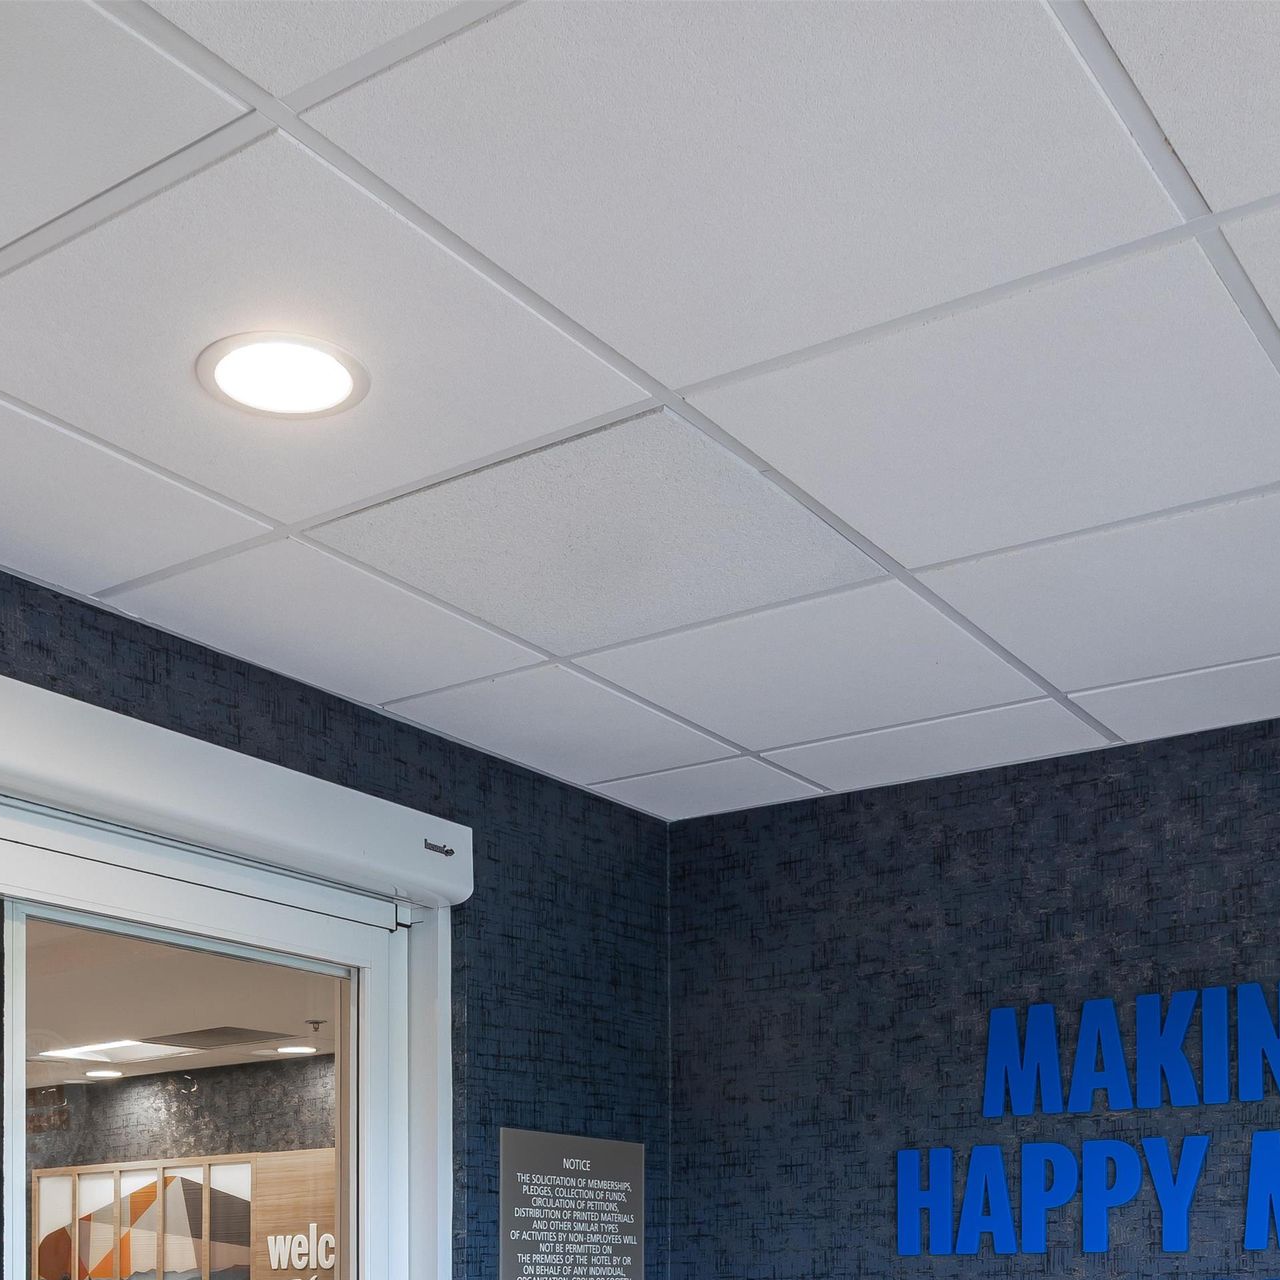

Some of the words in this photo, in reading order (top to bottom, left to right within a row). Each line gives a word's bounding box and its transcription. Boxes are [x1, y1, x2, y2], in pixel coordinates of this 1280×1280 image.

[563, 1158, 591, 1171] NOTICE
[517, 1173, 530, 1183] THE
[532, 1174, 576, 1186] SOLICITATION
[578, 1178, 587, 1187] OF
[588, 1179, 632, 1192] MEMBERSHIPS,
[522, 1185, 553, 1197] PLEDGES,
[555, 1189, 594, 1199] COLLECTION
[596, 1191, 605, 1199] OF
[606, 1192, 627, 1202] FUNDS,
[896, 1135, 1210, 1255] HAPPY
[532, 1198, 575, 1209] CIRCULATION
[577, 1202, 585, 1210] OF
[587, 1202, 619, 1212] PETITIONS,
[514, 1208, 561, 1219] DISTRIBUTION
[563, 1211, 572, 1219] OF
[573, 1212, 599, 1221] PRINTED
[601, 1214, 634, 1223] MATERIALS
[532, 1221, 548, 1230] AND
[550, 1222, 572, 1231] OTHER
[573, 1223, 599, 1232] SIMILAR
[600, 1224, 618, 1233] TYPES
[510, 1231, 520, 1240] OF
[522, 1232, 557, 1241] ACTIVITIES
[558, 1233, 567, 1242] BY
[568, 1233, 622, 1244] NON-EMPLOYEES
[623, 1236, 638, 1244] WILL
[539, 1243, 554, 1252] NOT
[556, 1244, 564, 1252] BE
[566, 1244, 601, 1253] PERMITTED
[602, 1245, 612, 1254] ON
[517, 1254, 531, 1263] THE
[532, 1255, 563, 1264] PREMISES
[565, 1255, 574, 1264] OF
[576, 1256, 587, 1264] THE
[592, 1256, 611, 1265] HOTEL
[613, 1257, 621, 1265] BY
[622, 1257, 632, 1265] OR
[523, 1266, 534, 1275] ON
[536, 1266, 561, 1275] BEHALF
[563, 1267, 572, 1275] OF
[573, 1267, 587, 1275] ANY
[589, 1267, 626, 1277] INDIVIDUAL,
